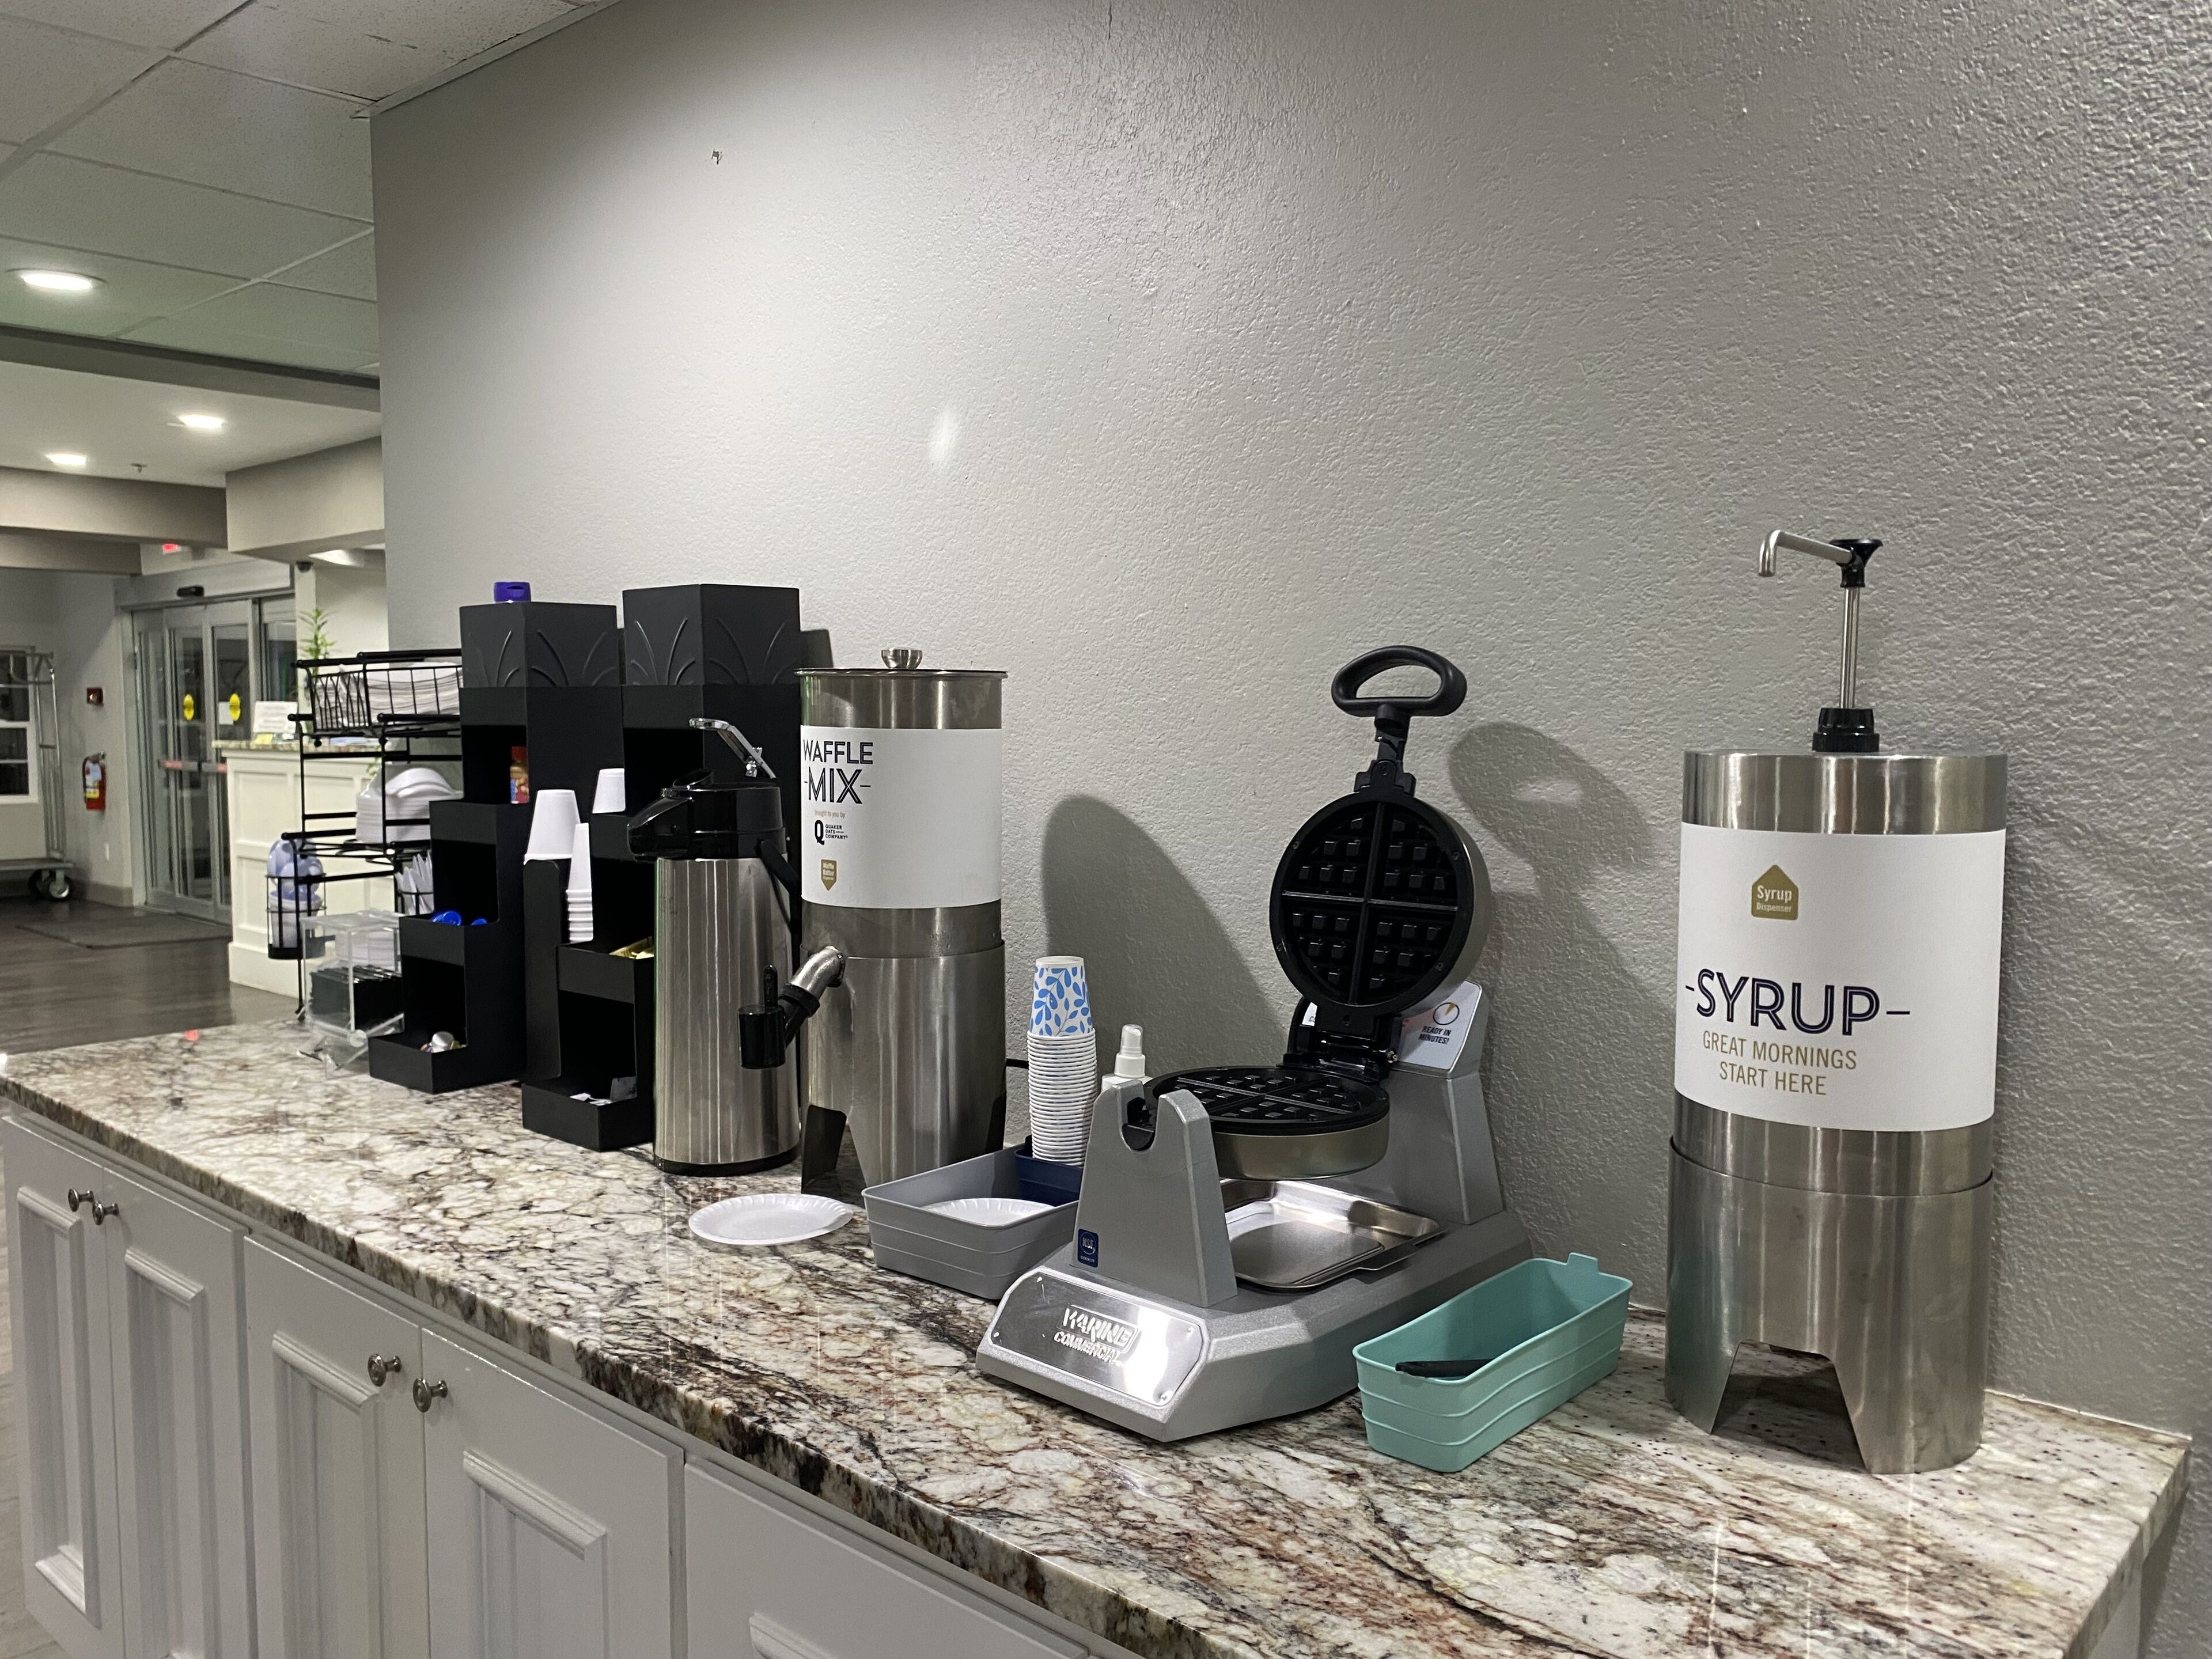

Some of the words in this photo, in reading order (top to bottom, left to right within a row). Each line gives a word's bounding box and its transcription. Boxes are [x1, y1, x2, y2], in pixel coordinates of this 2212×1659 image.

[803, 739, 873, 764] WAFFLE
[1757, 885, 1792, 903] Syrup
[1419, 1033, 1449, 1044] MINUTES!
[1422, 1025, 1443, 1035] READY
[1703, 1031, 1747, 1057] GREAT
[1753, 1040, 1857, 1070] MORNINGS
[1719, 1061, 1767, 1088] START
[1775, 1071, 1827, 1096] HERE
